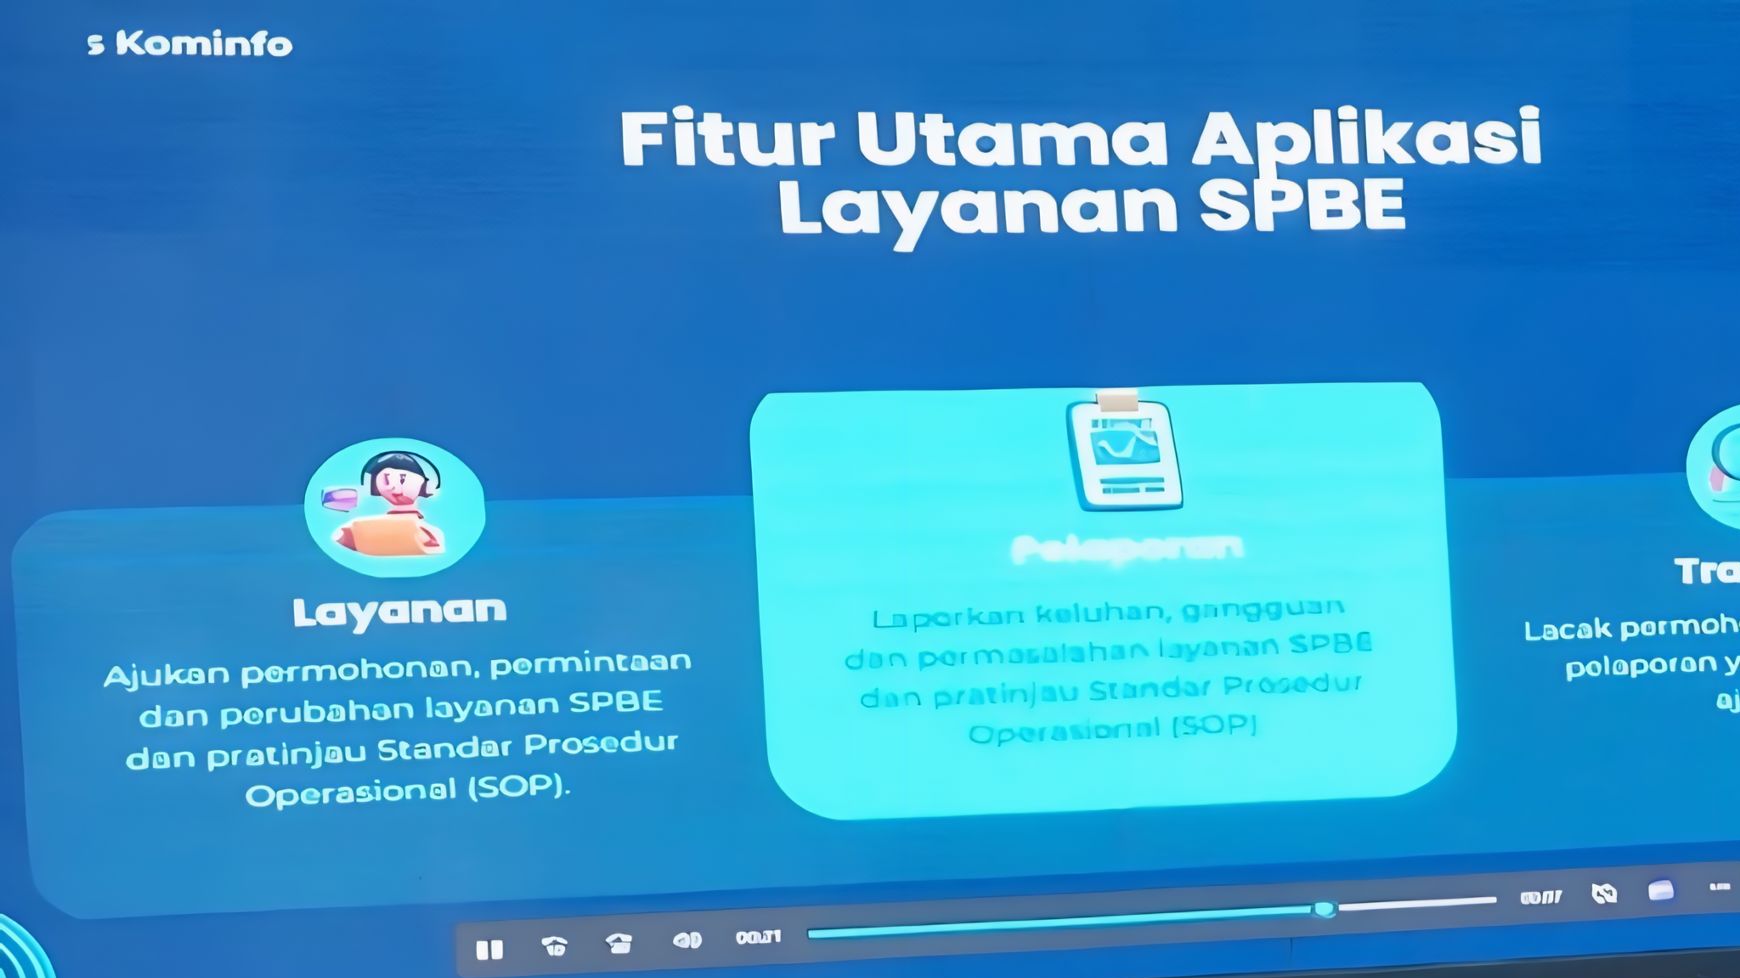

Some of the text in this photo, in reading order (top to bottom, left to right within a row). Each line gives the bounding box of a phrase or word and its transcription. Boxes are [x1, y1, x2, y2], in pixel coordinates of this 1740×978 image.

[116, 28, 293, 57] Kominfo
[621, 104, 1542, 181] Fitur Utama Aplikasi
[779, 176, 1406, 253] Layanan SPBE
[293, 598, 507, 635] Layanan
[1524, 616, 1613, 642] Lacak
[103, 649, 692, 693] Ajukan permohonan, permintaan
[139, 689, 664, 730] dan perubahan layanan SPBE
[125, 729, 679, 772] dan pratinjau Standar Prosedur
[245, 772, 571, 811] Operasional (SOP).
